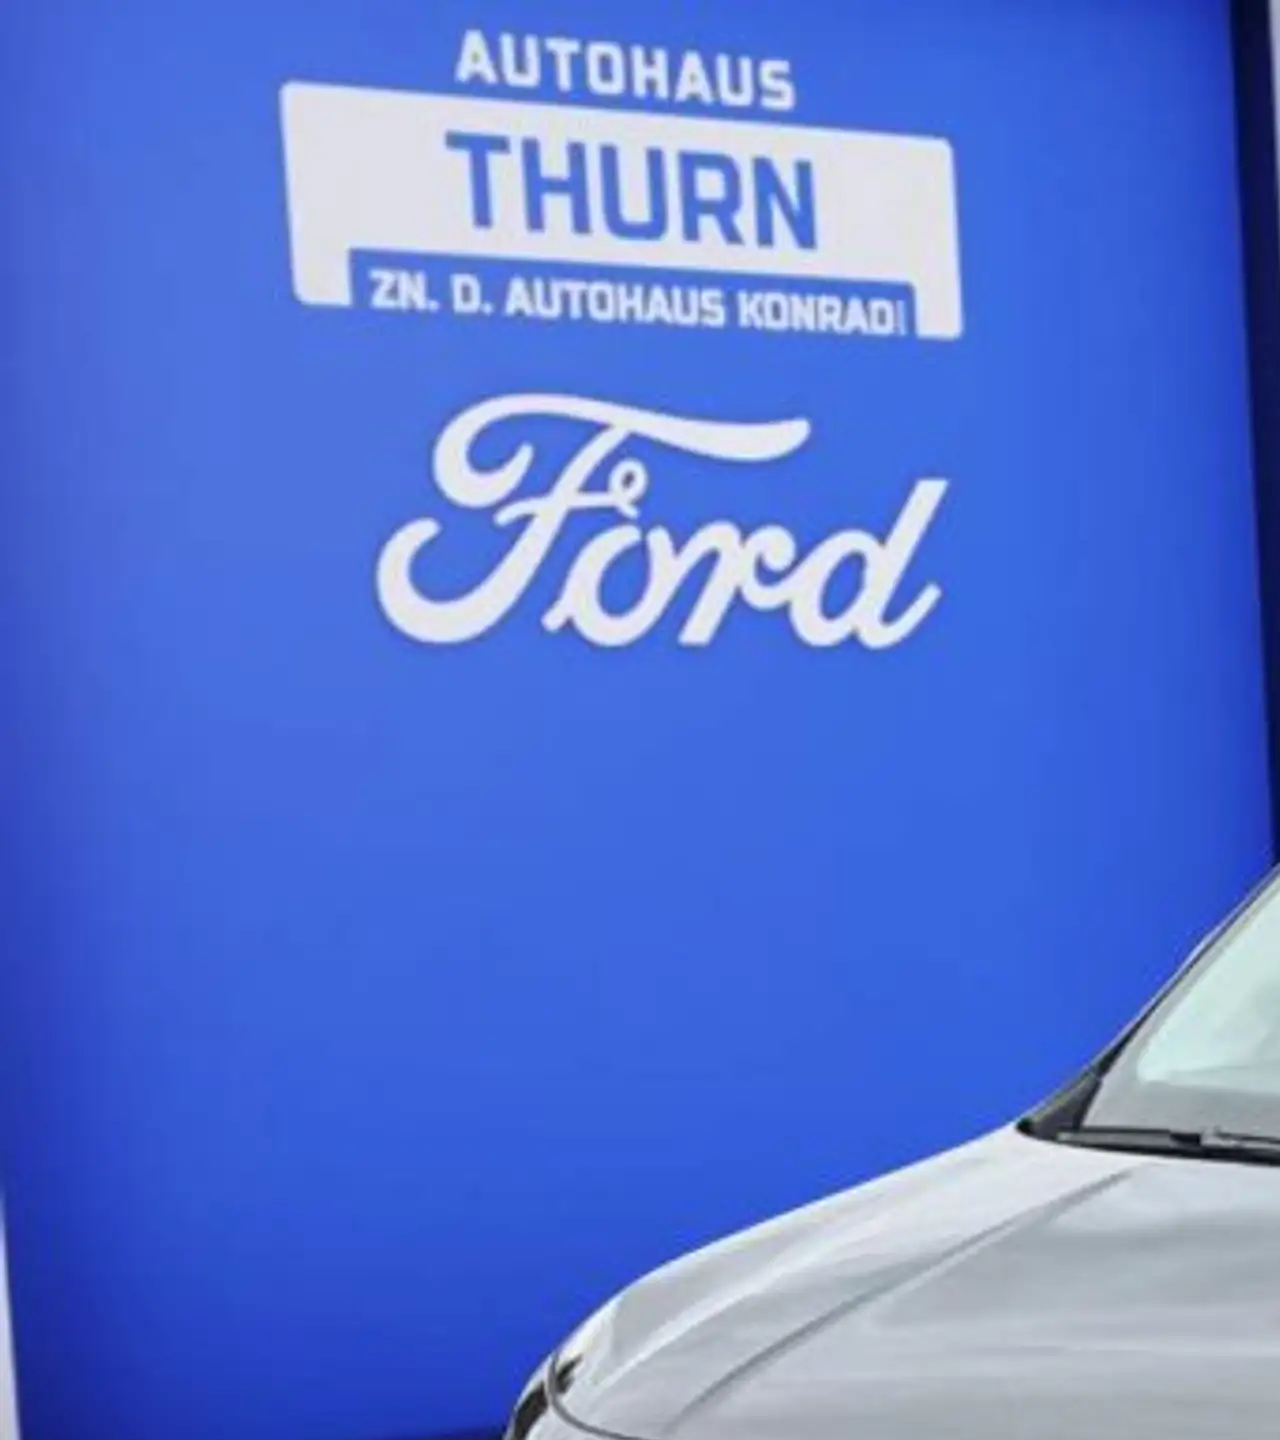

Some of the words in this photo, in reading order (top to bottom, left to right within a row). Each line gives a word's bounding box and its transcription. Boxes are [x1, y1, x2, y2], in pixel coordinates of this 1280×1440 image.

[455, 29, 796, 110] AUTOHAUS
[445, 131, 817, 250] THURN
[369, 270, 439, 313] ZN.
[452, 276, 494, 316] D.
[505, 278, 727, 328] AUTOHAUS
[738, 290, 894, 336] KONRAD
[376, 393, 950, 651] Ford
